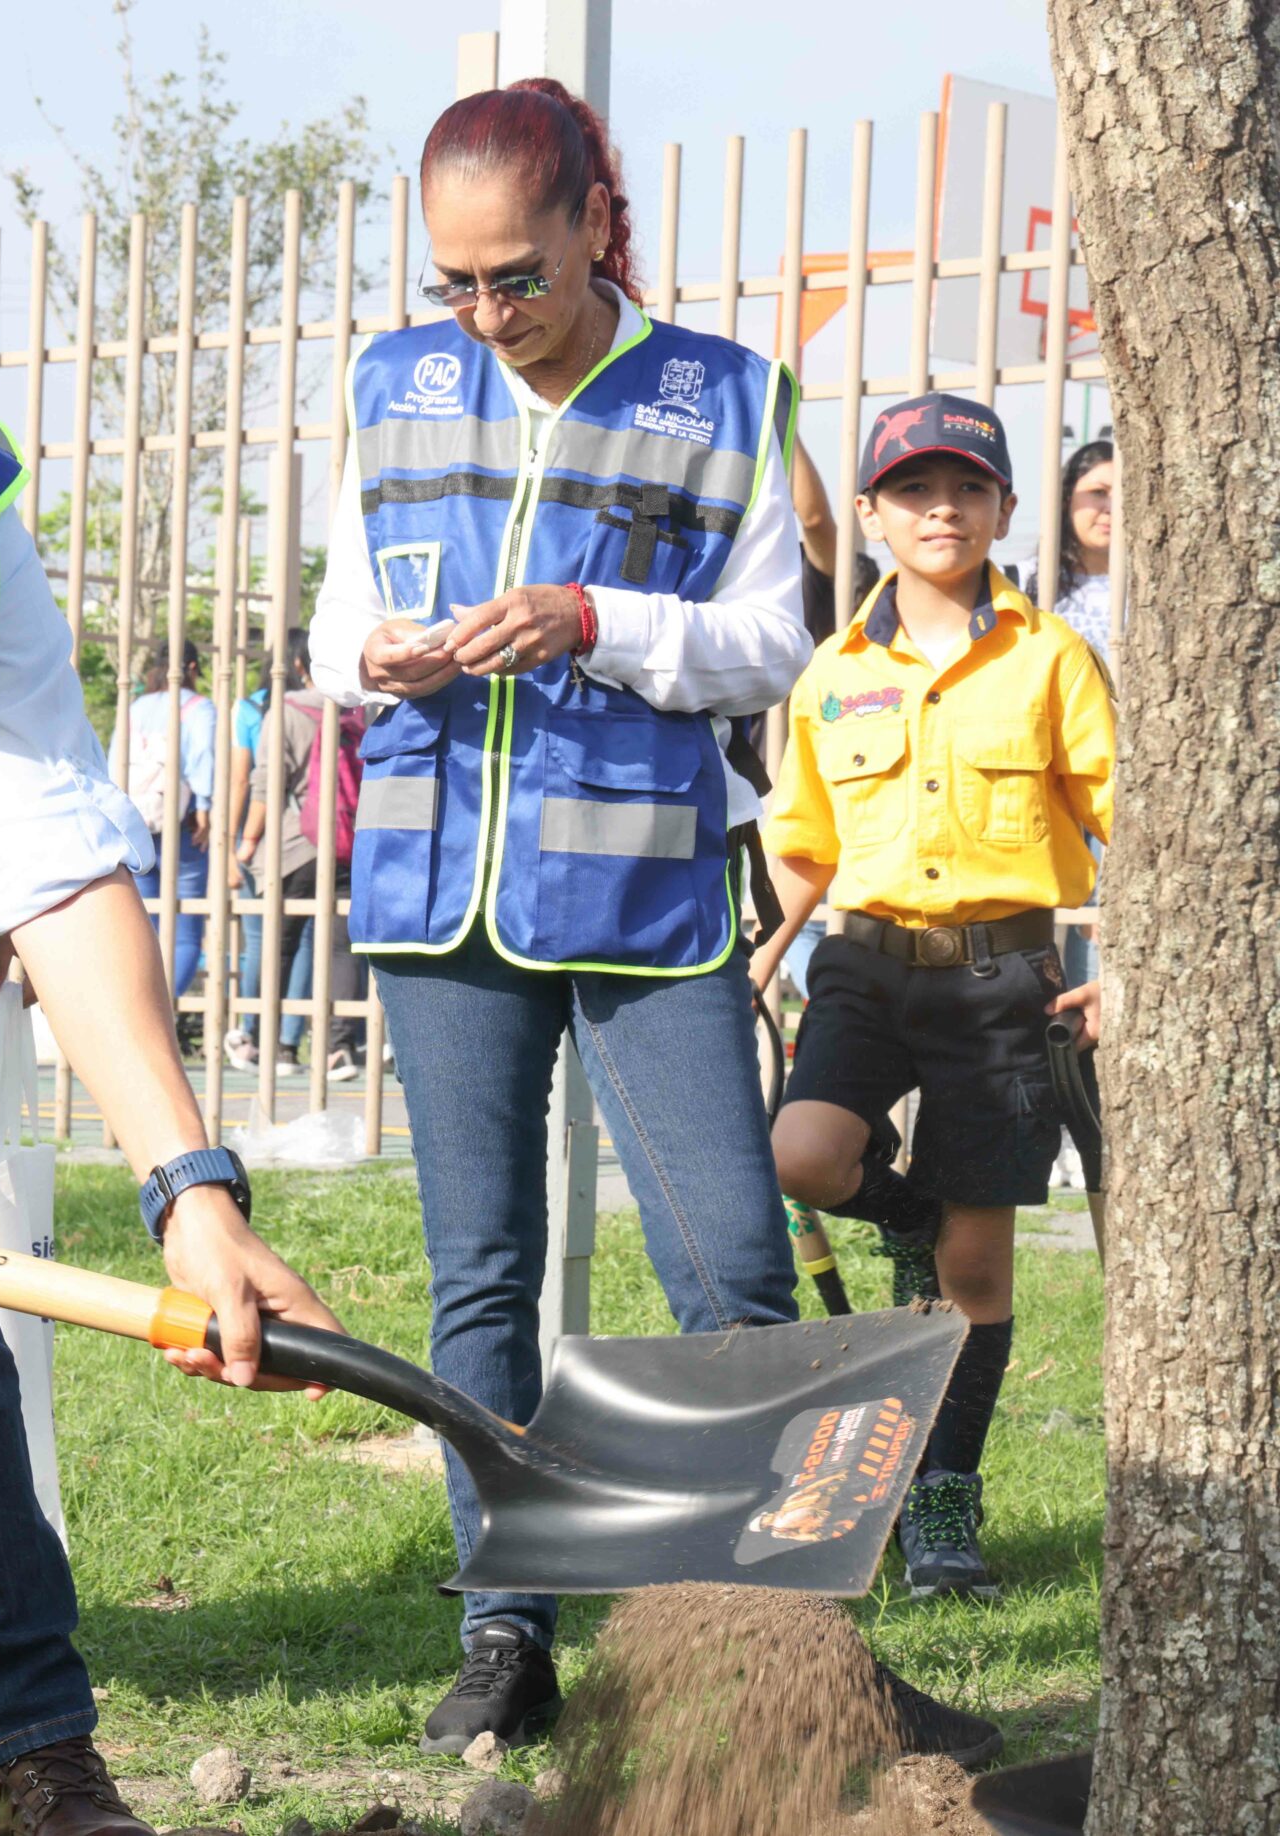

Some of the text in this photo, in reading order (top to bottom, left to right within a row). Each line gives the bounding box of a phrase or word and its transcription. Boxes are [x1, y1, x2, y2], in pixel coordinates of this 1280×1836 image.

[420, 360, 456, 386] PAC
[405, 391, 458, 406] Programa
[636, 404, 660, 417] SAN
[665, 411, 714, 431] NICOLÁS
[877, 1420, 912, 1482] TRUPER
